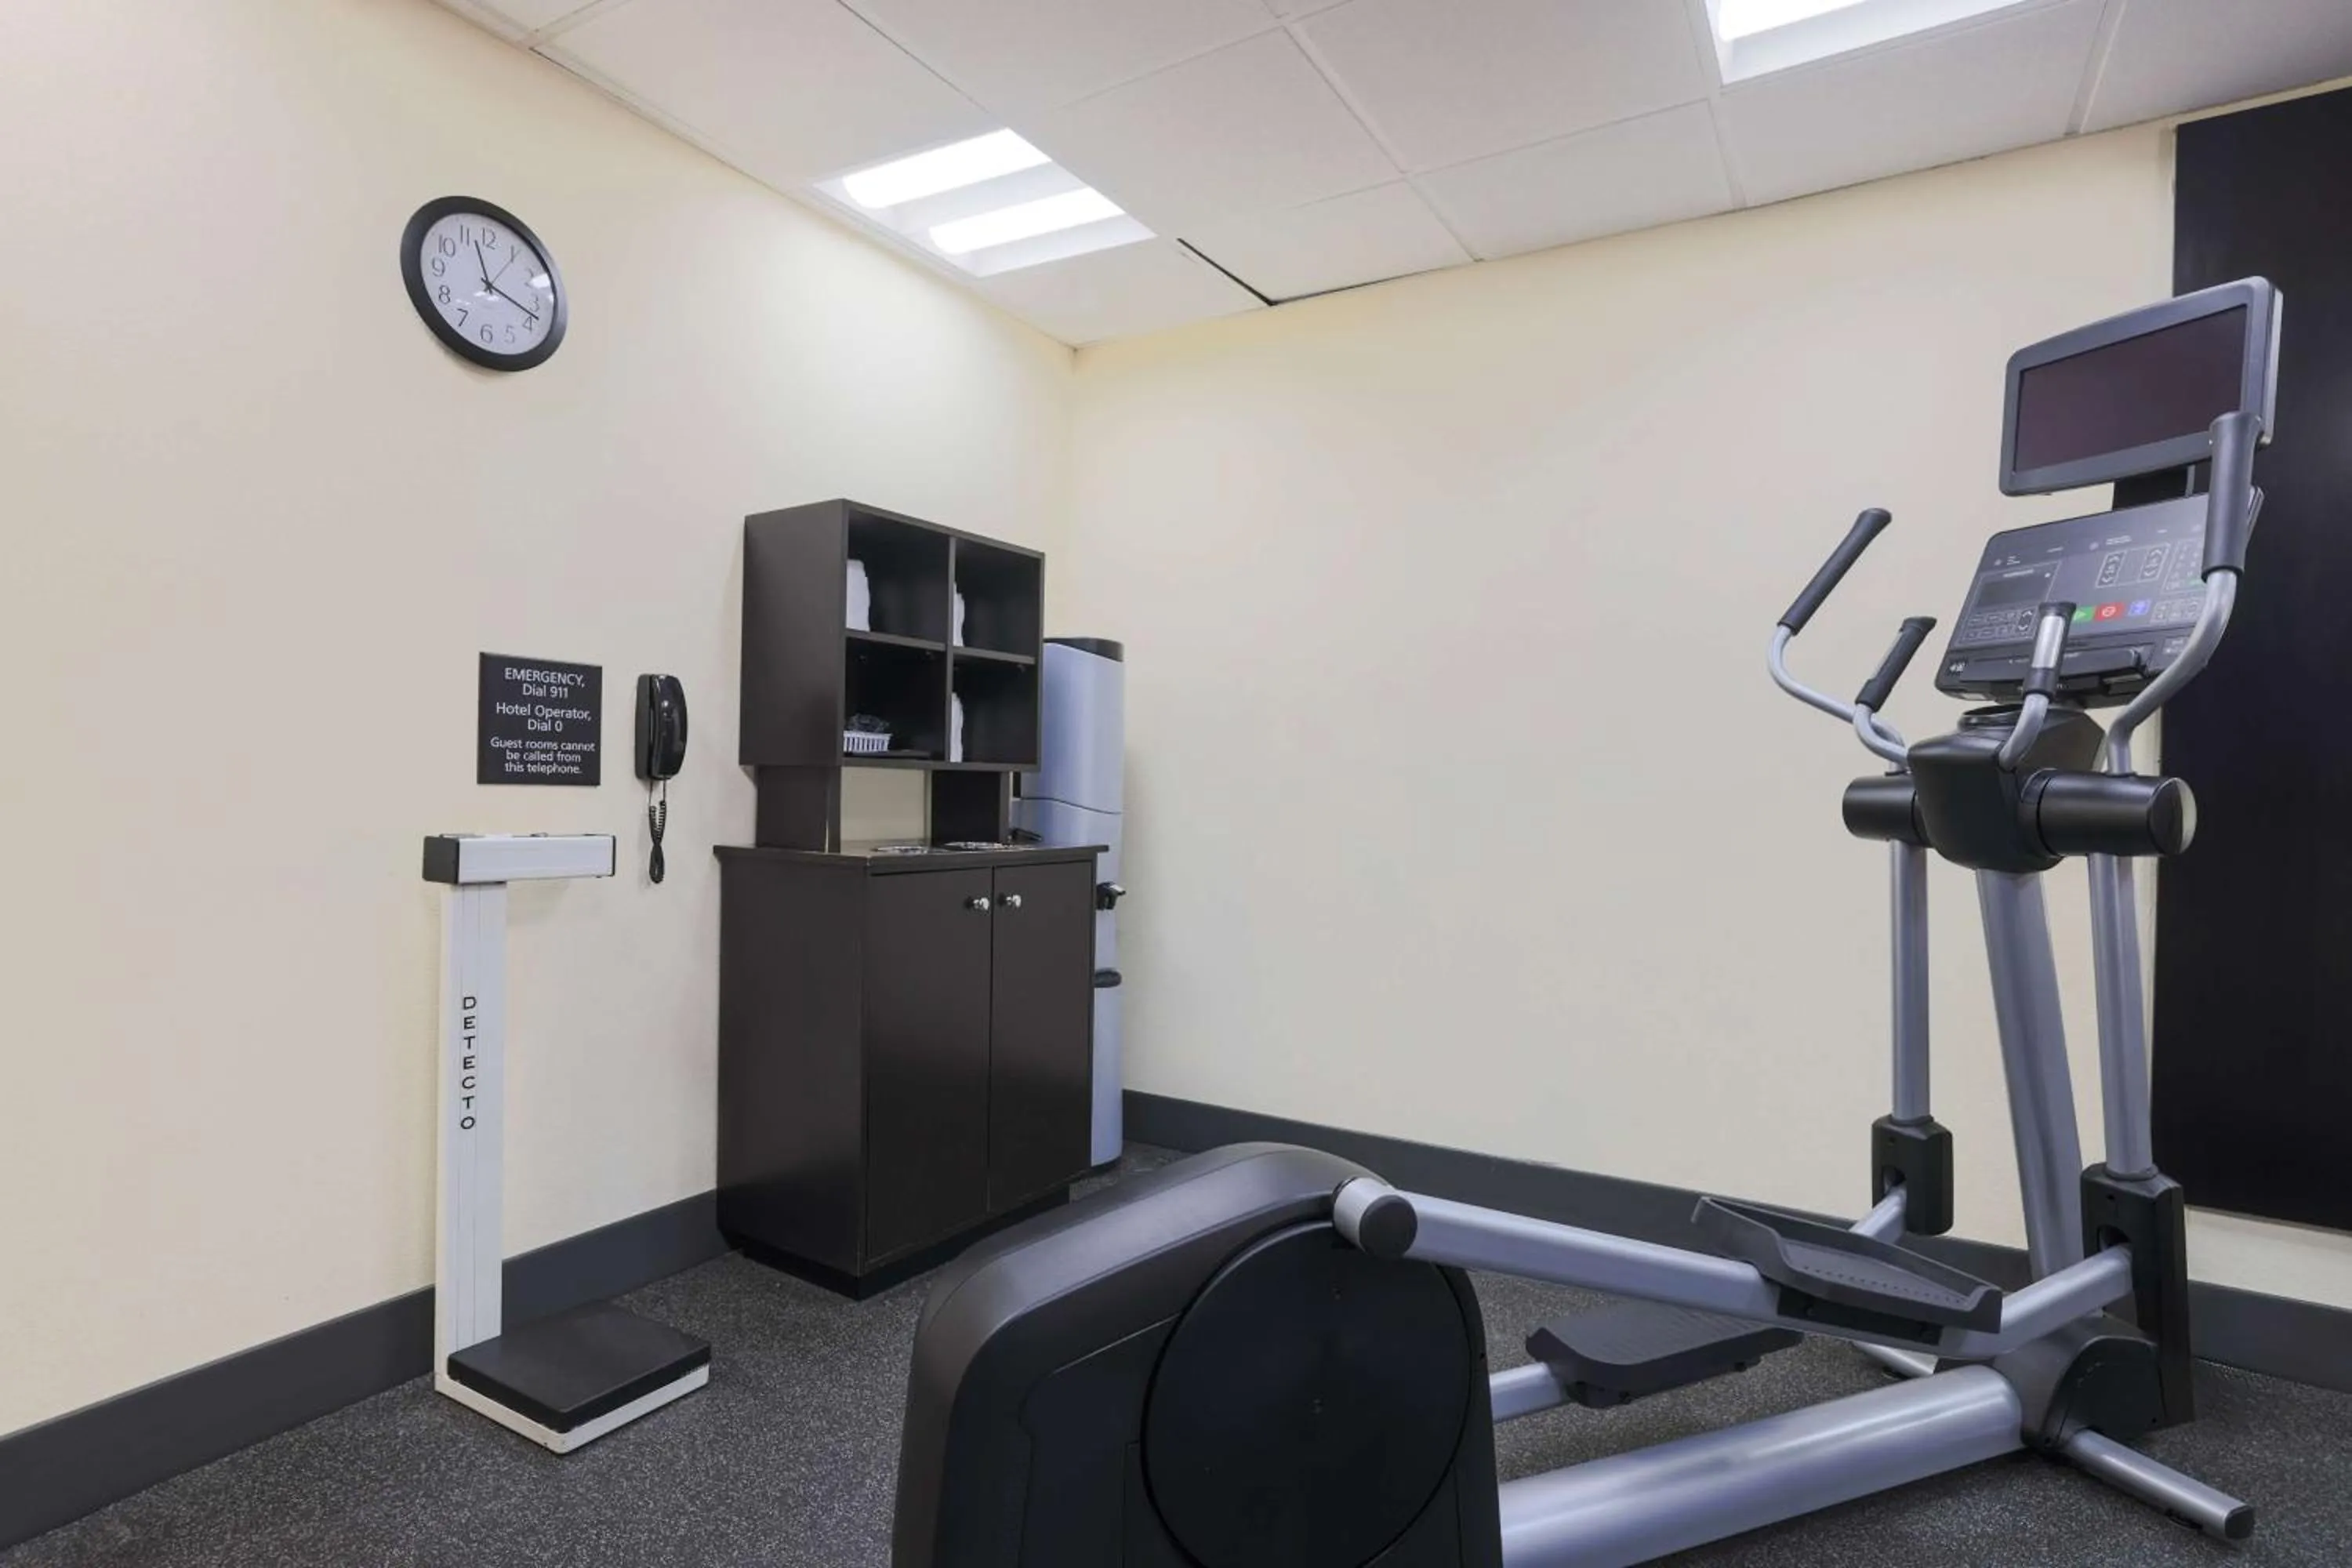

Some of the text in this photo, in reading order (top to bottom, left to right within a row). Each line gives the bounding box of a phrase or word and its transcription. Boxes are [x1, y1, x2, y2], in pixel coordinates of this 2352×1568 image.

[460, 224, 470, 246] 11
[481, 227, 497, 250] 12
[438, 235, 456, 258] 10
[432, 257, 445, 277] 9
[438, 285, 451, 304] 8
[457, 308, 469, 327] 7
[522, 315, 533, 333] 4
[480, 324, 493, 343] 6
[505, 325, 515, 343] 5
[504, 667, 585, 688] EMERGENCY,
[523, 683, 568, 699] Dial 911
[496, 702, 591, 721] Hotel Operator,
[528, 719, 563, 732] Dial 0
[490, 737, 595, 752] Guest rooms cannot
[506, 750, 581, 763] be called from
[505, 761, 582, 775] this telephone.
[460, 996, 477, 1130] DETECTO
